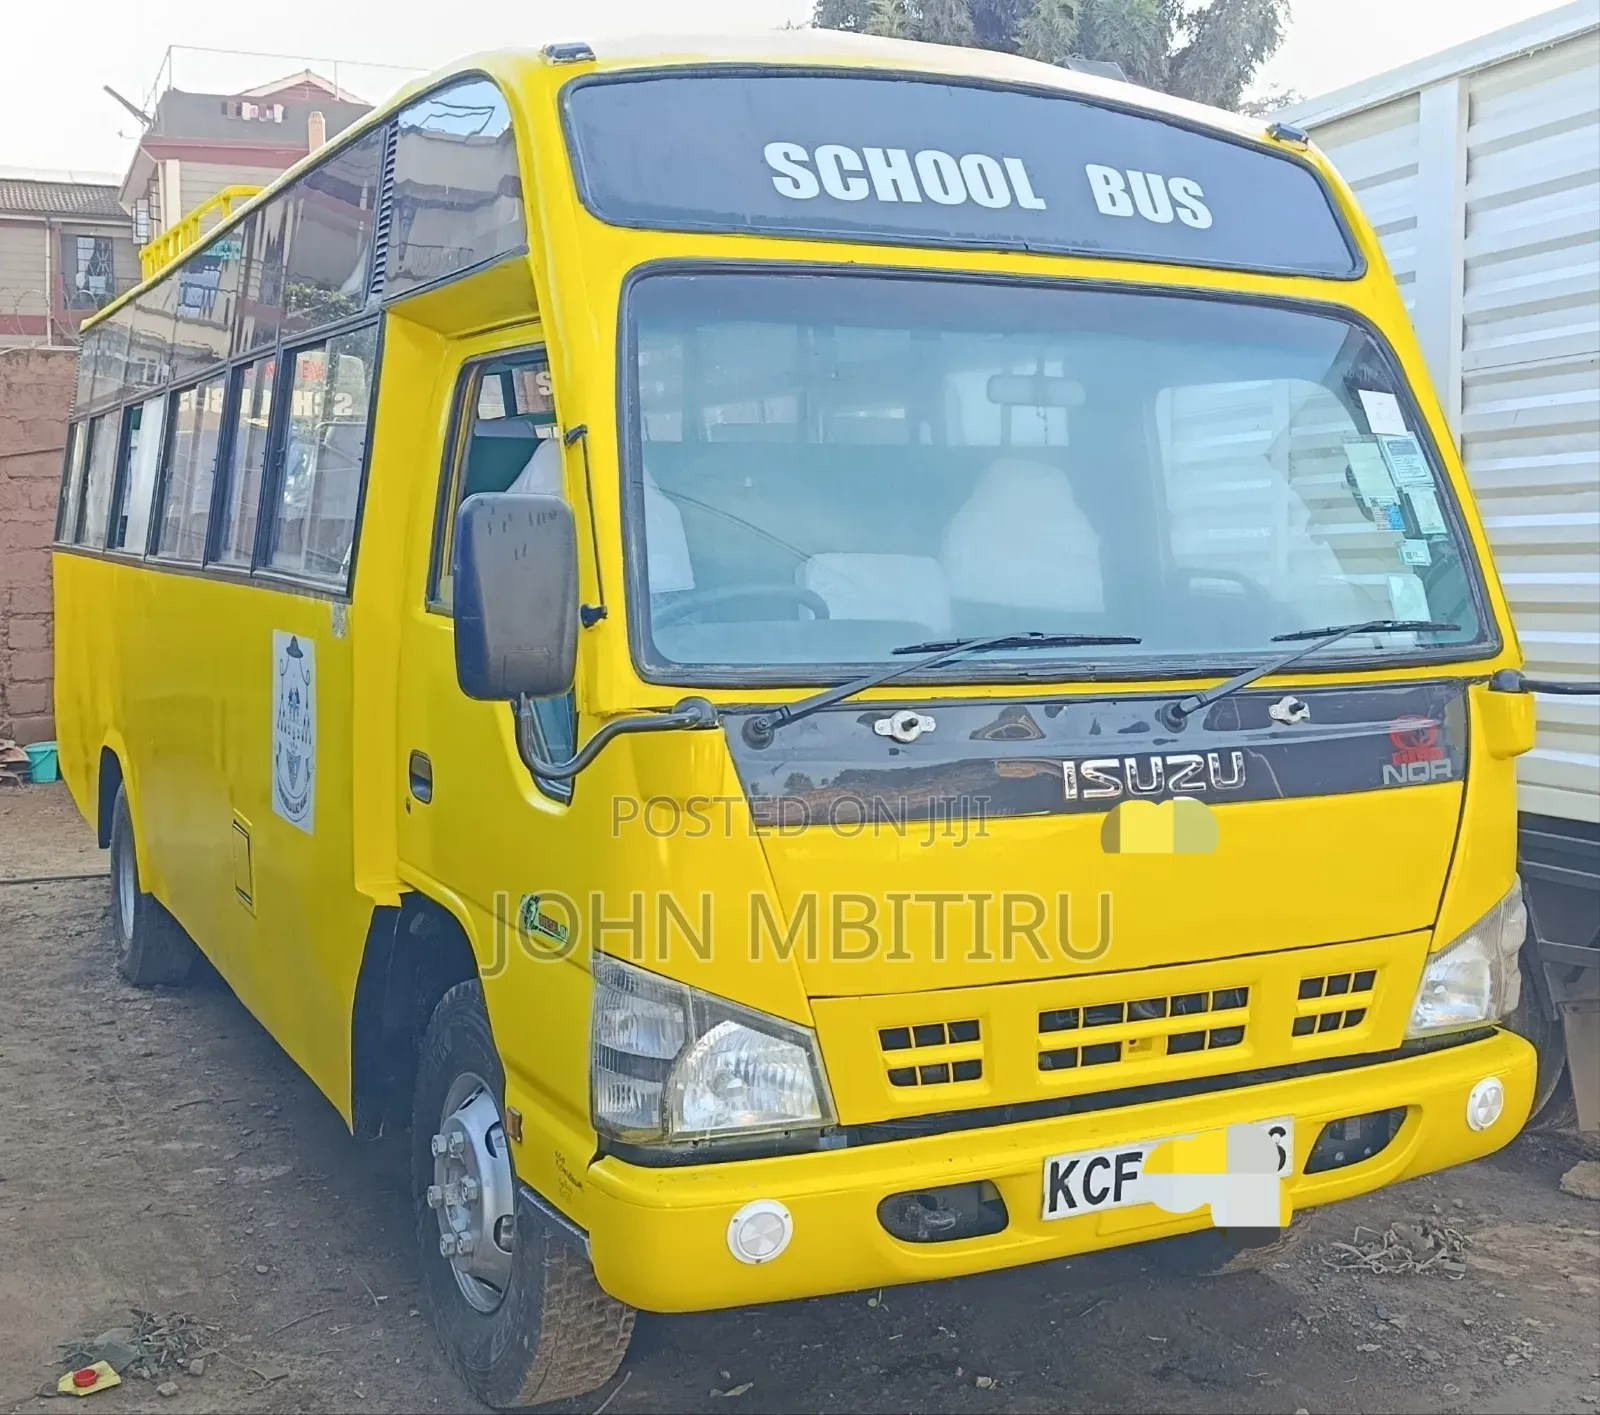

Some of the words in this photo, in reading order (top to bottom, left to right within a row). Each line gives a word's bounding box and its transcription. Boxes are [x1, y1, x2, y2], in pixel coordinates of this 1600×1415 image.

[763, 141, 1047, 210] SCHOOL
[1084, 163, 1213, 230] BUS
[1062, 751, 1246, 800] ISUZU
[1382, 758, 1453, 785] NQR
[1048, 1151, 1143, 1214] KCF
